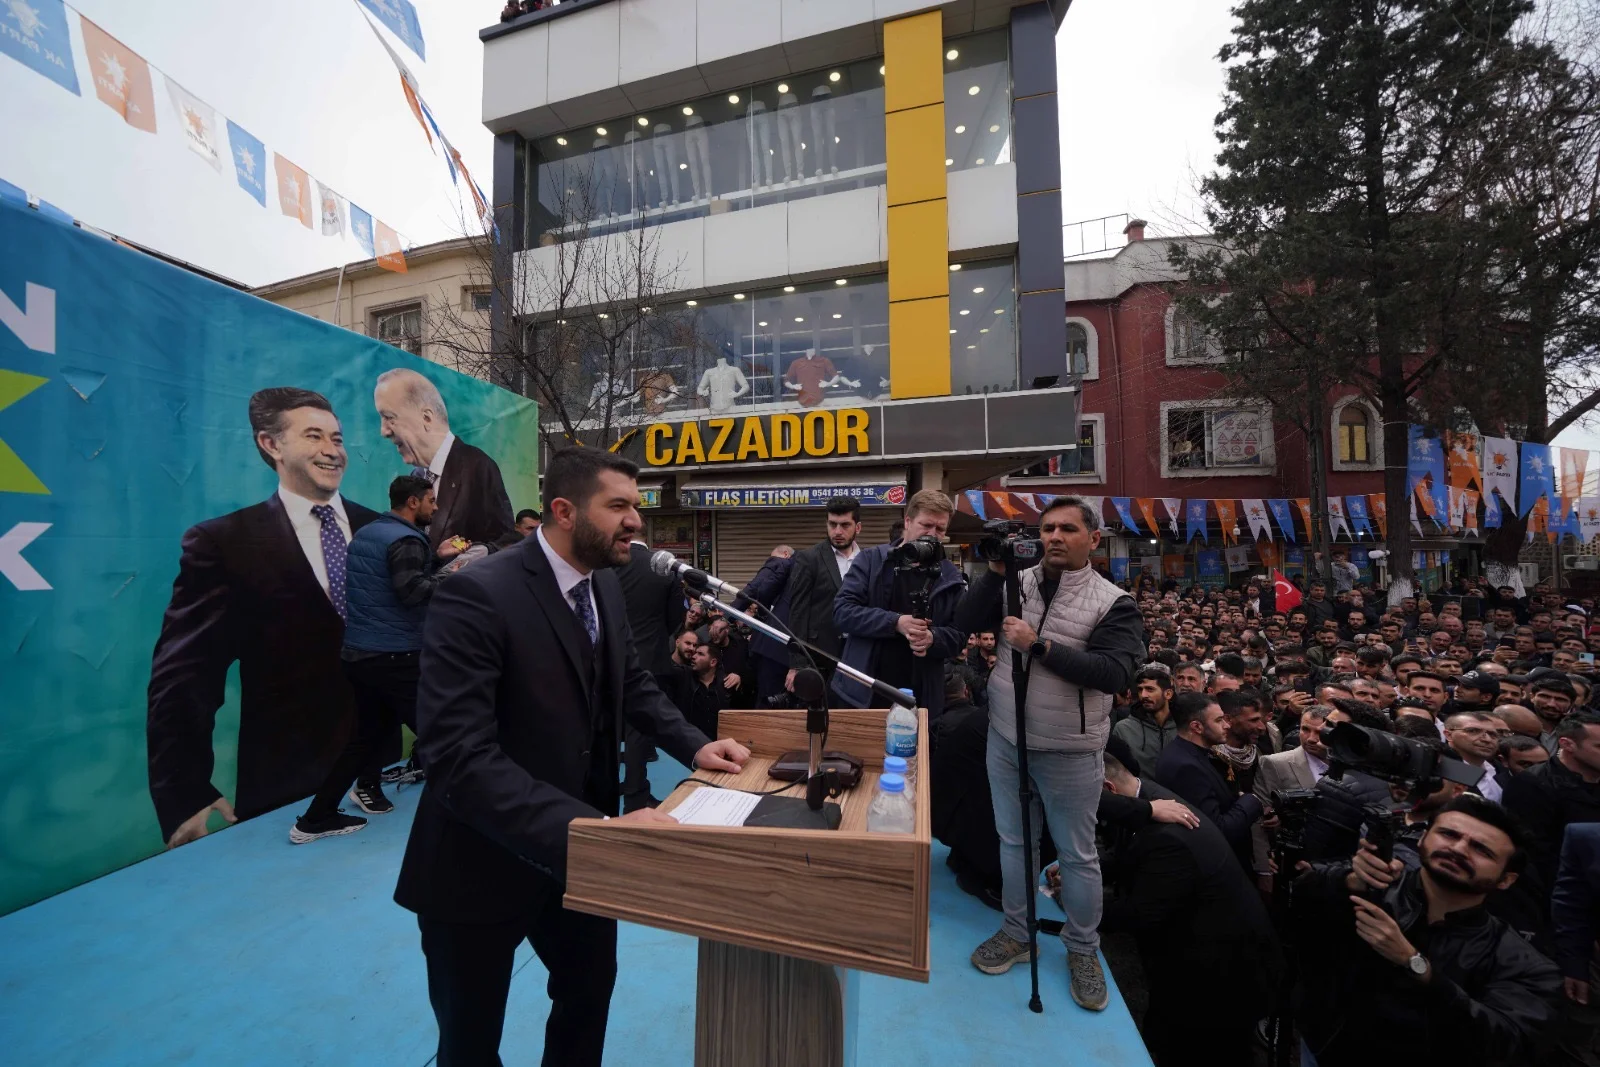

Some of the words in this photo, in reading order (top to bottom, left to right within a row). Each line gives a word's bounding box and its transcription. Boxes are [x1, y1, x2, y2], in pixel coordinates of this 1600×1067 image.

[645, 408, 870, 466] CAZADOR
[705, 491, 738, 506] FLAŞ
[812, 489, 831, 497] 0541
[833, 488, 849, 497] 264
[850, 488, 862, 496] 35
[863, 487, 874, 496] 36
